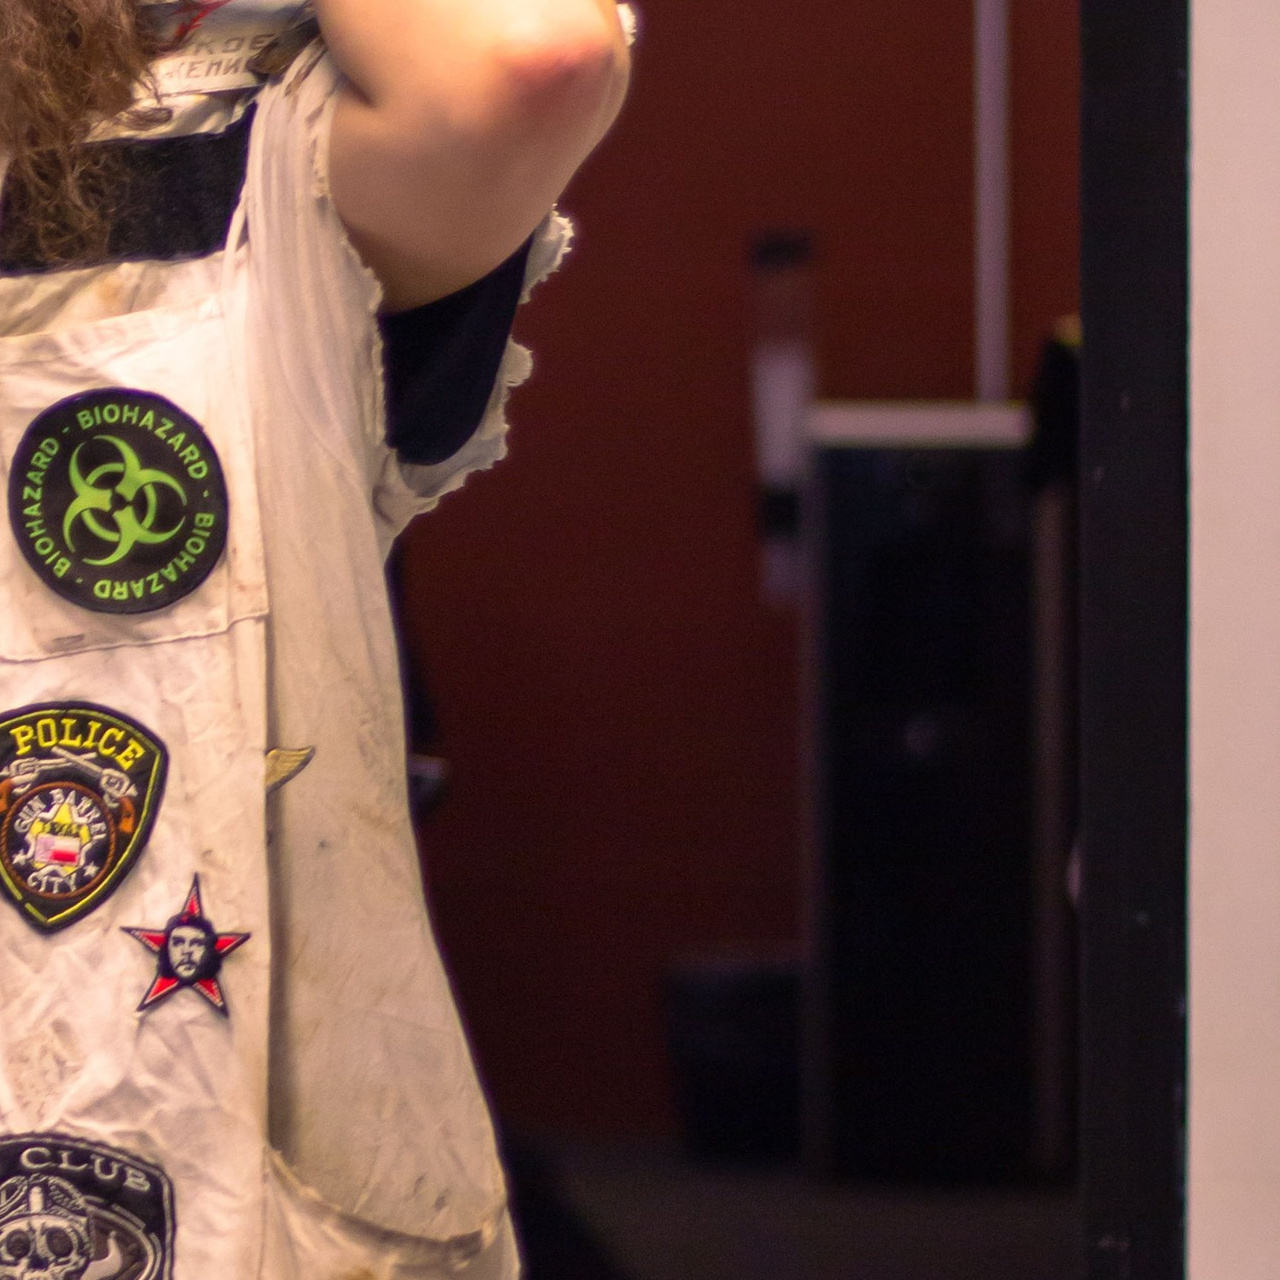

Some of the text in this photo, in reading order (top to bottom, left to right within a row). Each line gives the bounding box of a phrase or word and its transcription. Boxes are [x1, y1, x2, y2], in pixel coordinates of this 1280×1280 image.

[76, 404, 208, 479] BIOHAZARD
[23, 437, 71, 578] BIOHAZARD
[93, 511, 215, 600] BIOHAZARD
[9, 717, 145, 770] POLICE
[20, 1146, 152, 1193] CLUB
